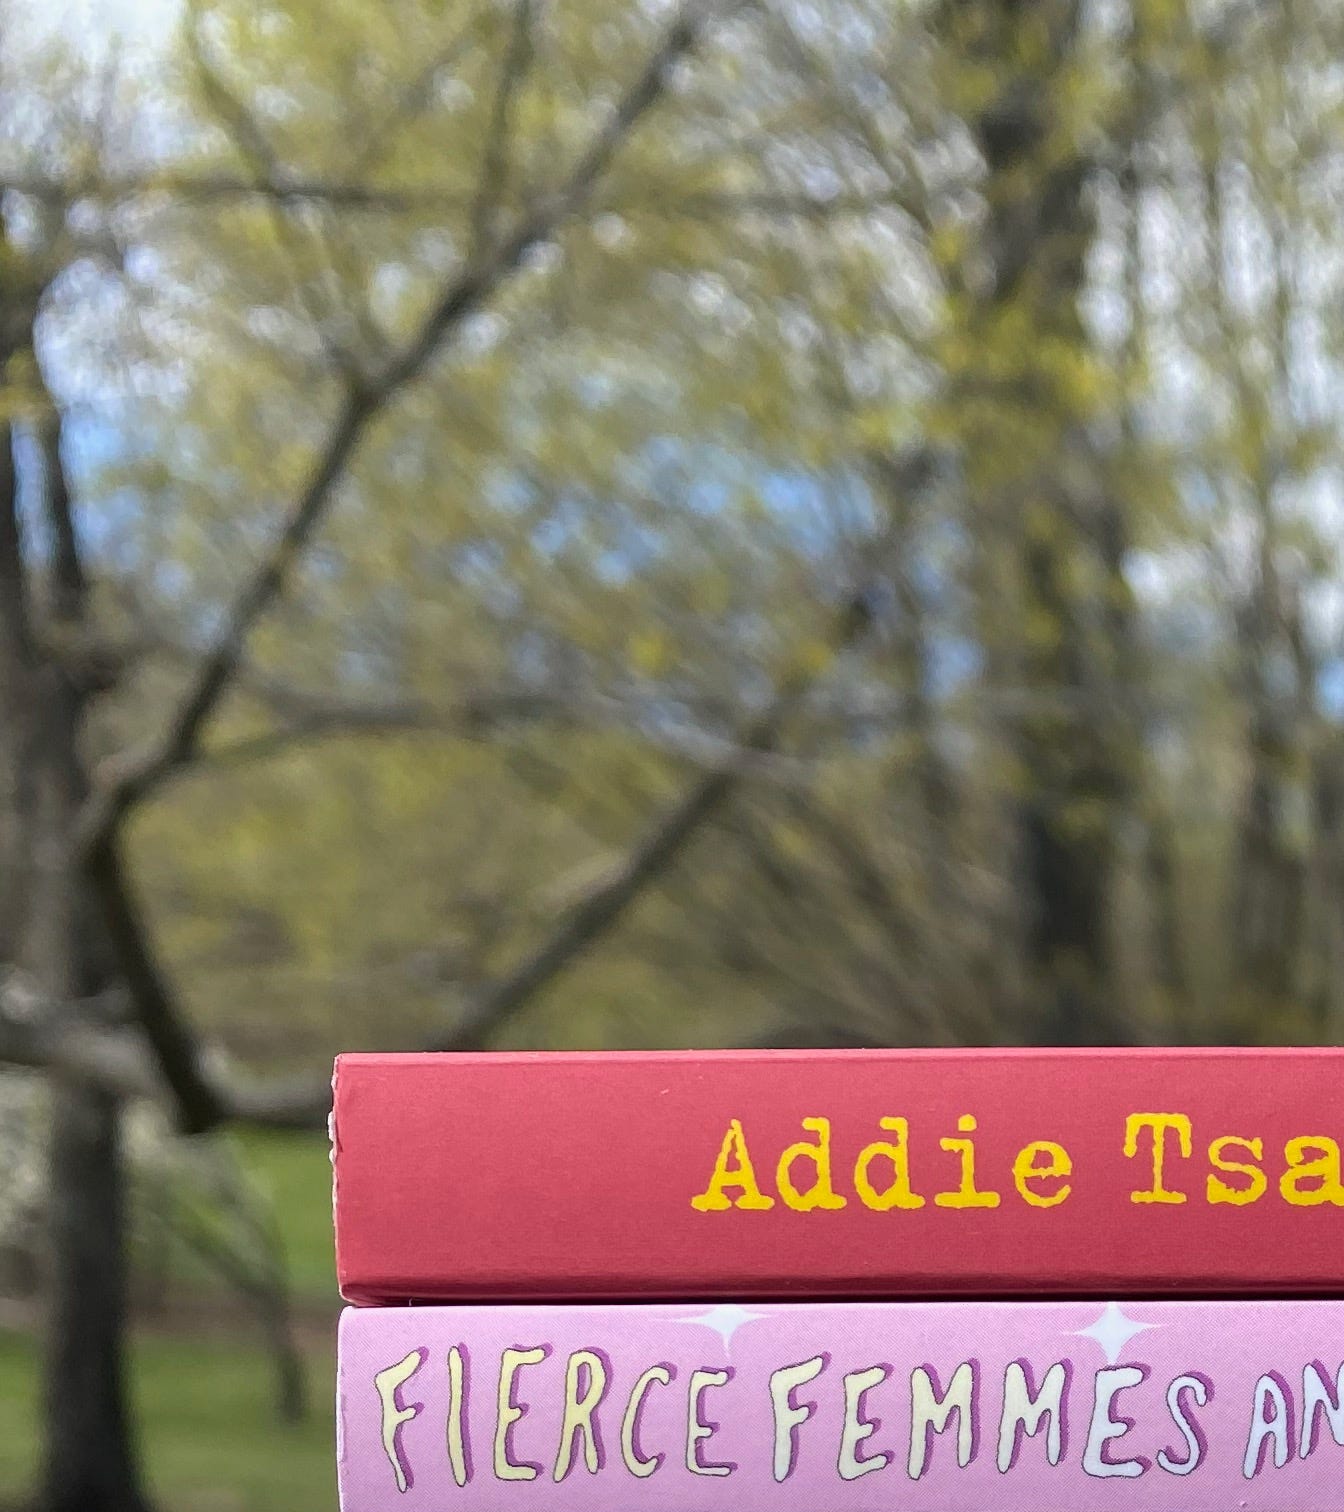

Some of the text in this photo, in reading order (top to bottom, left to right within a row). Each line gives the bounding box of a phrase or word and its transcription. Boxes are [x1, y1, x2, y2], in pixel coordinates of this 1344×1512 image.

[691, 1112, 1073, 1212] Addie
[374, 1345, 738, 1492] FIERCE
[768, 1352, 1214, 1482] FEMMES
